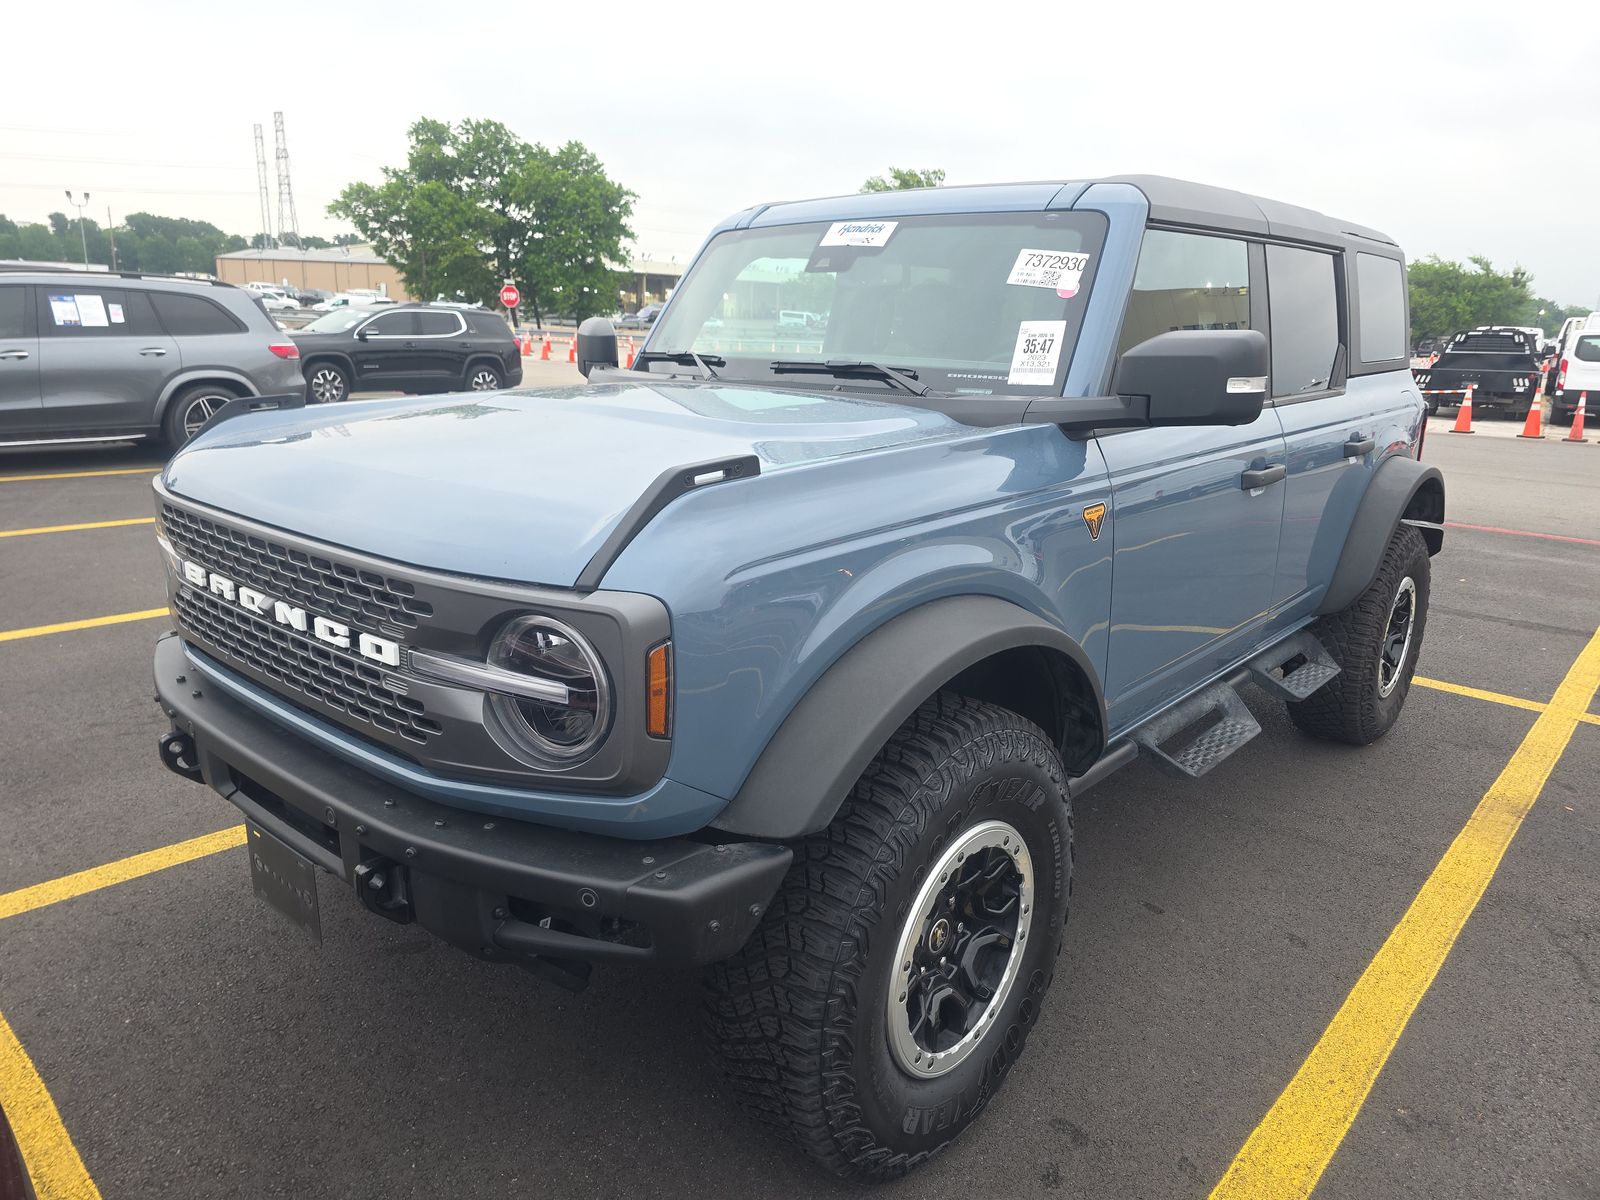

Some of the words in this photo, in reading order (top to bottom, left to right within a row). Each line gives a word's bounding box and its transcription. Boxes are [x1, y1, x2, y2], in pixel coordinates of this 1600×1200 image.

[1025, 254, 1088, 271] 7372930
[503, 292, 517, 301] STOP
[1023, 338, 1054, 354] 35:47
[184, 560, 400, 666] BRONCO
